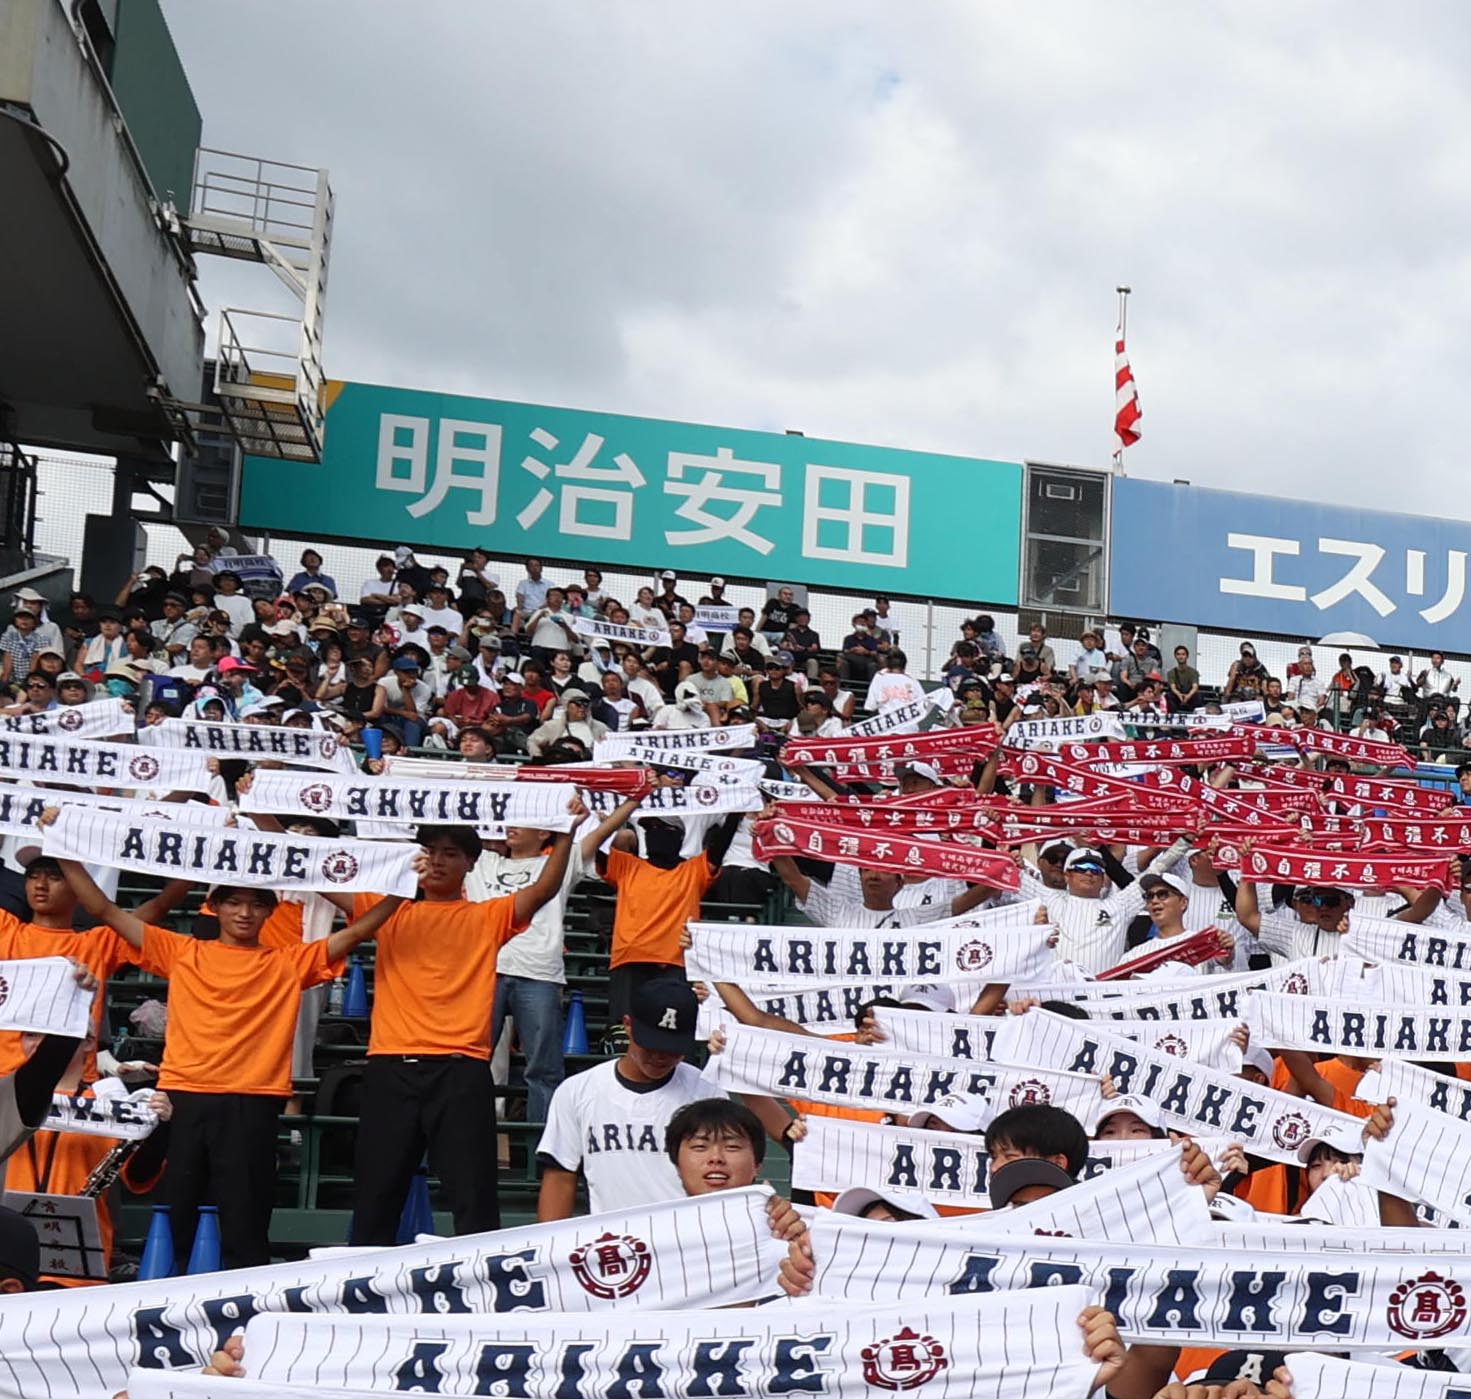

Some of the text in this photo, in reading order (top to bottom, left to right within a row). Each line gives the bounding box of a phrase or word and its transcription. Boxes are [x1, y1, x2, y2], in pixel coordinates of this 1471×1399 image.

[376, 412, 910, 568] 明治安田
[592, 621, 647, 641] ARIAKE
[850, 704, 921, 736] ARIAKE
[1017, 717, 1085, 739] ARIAKE
[185, 726, 311, 755] ARIAKE
[634, 732, 710, 746] ARIAKE
[347, 787, 511, 820] ARIAKE
[121, 828, 307, 879] ARIAKE
[753, 938, 942, 975] ARIAKE
[657, 1008, 677, 1030] A
[779, 1051, 996, 1101] ARIAKE
[1071, 1040, 1266, 1137] ARIAKE
[590, 1125, 673, 1151] ARIA
[400, 1334, 832, 1398] ARIAKE
[1236, 1352, 1263, 1383] A
